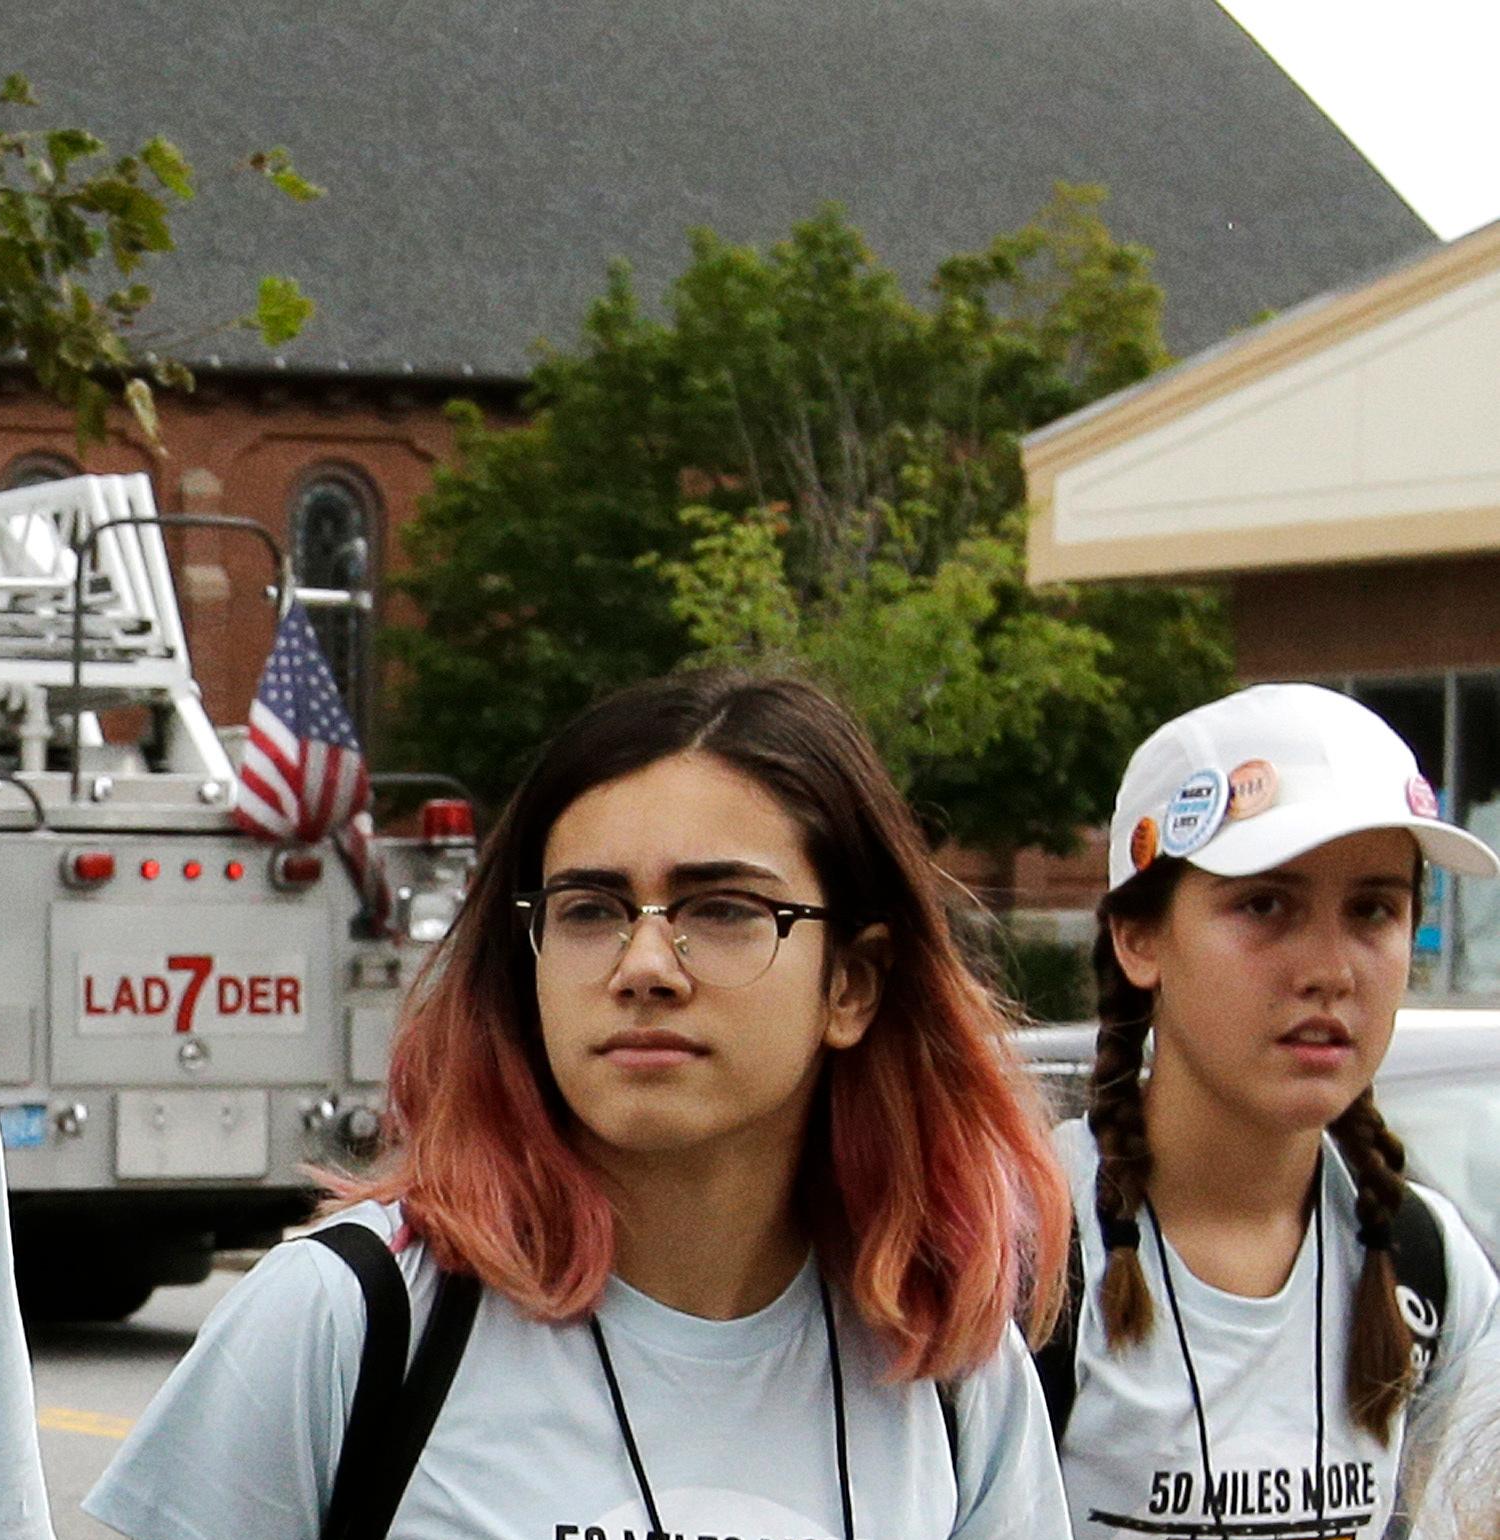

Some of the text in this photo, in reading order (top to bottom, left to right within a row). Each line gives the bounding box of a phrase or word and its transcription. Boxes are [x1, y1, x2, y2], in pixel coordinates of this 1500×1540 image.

[1148, 1461, 1376, 1516] 50 MILES MORE
